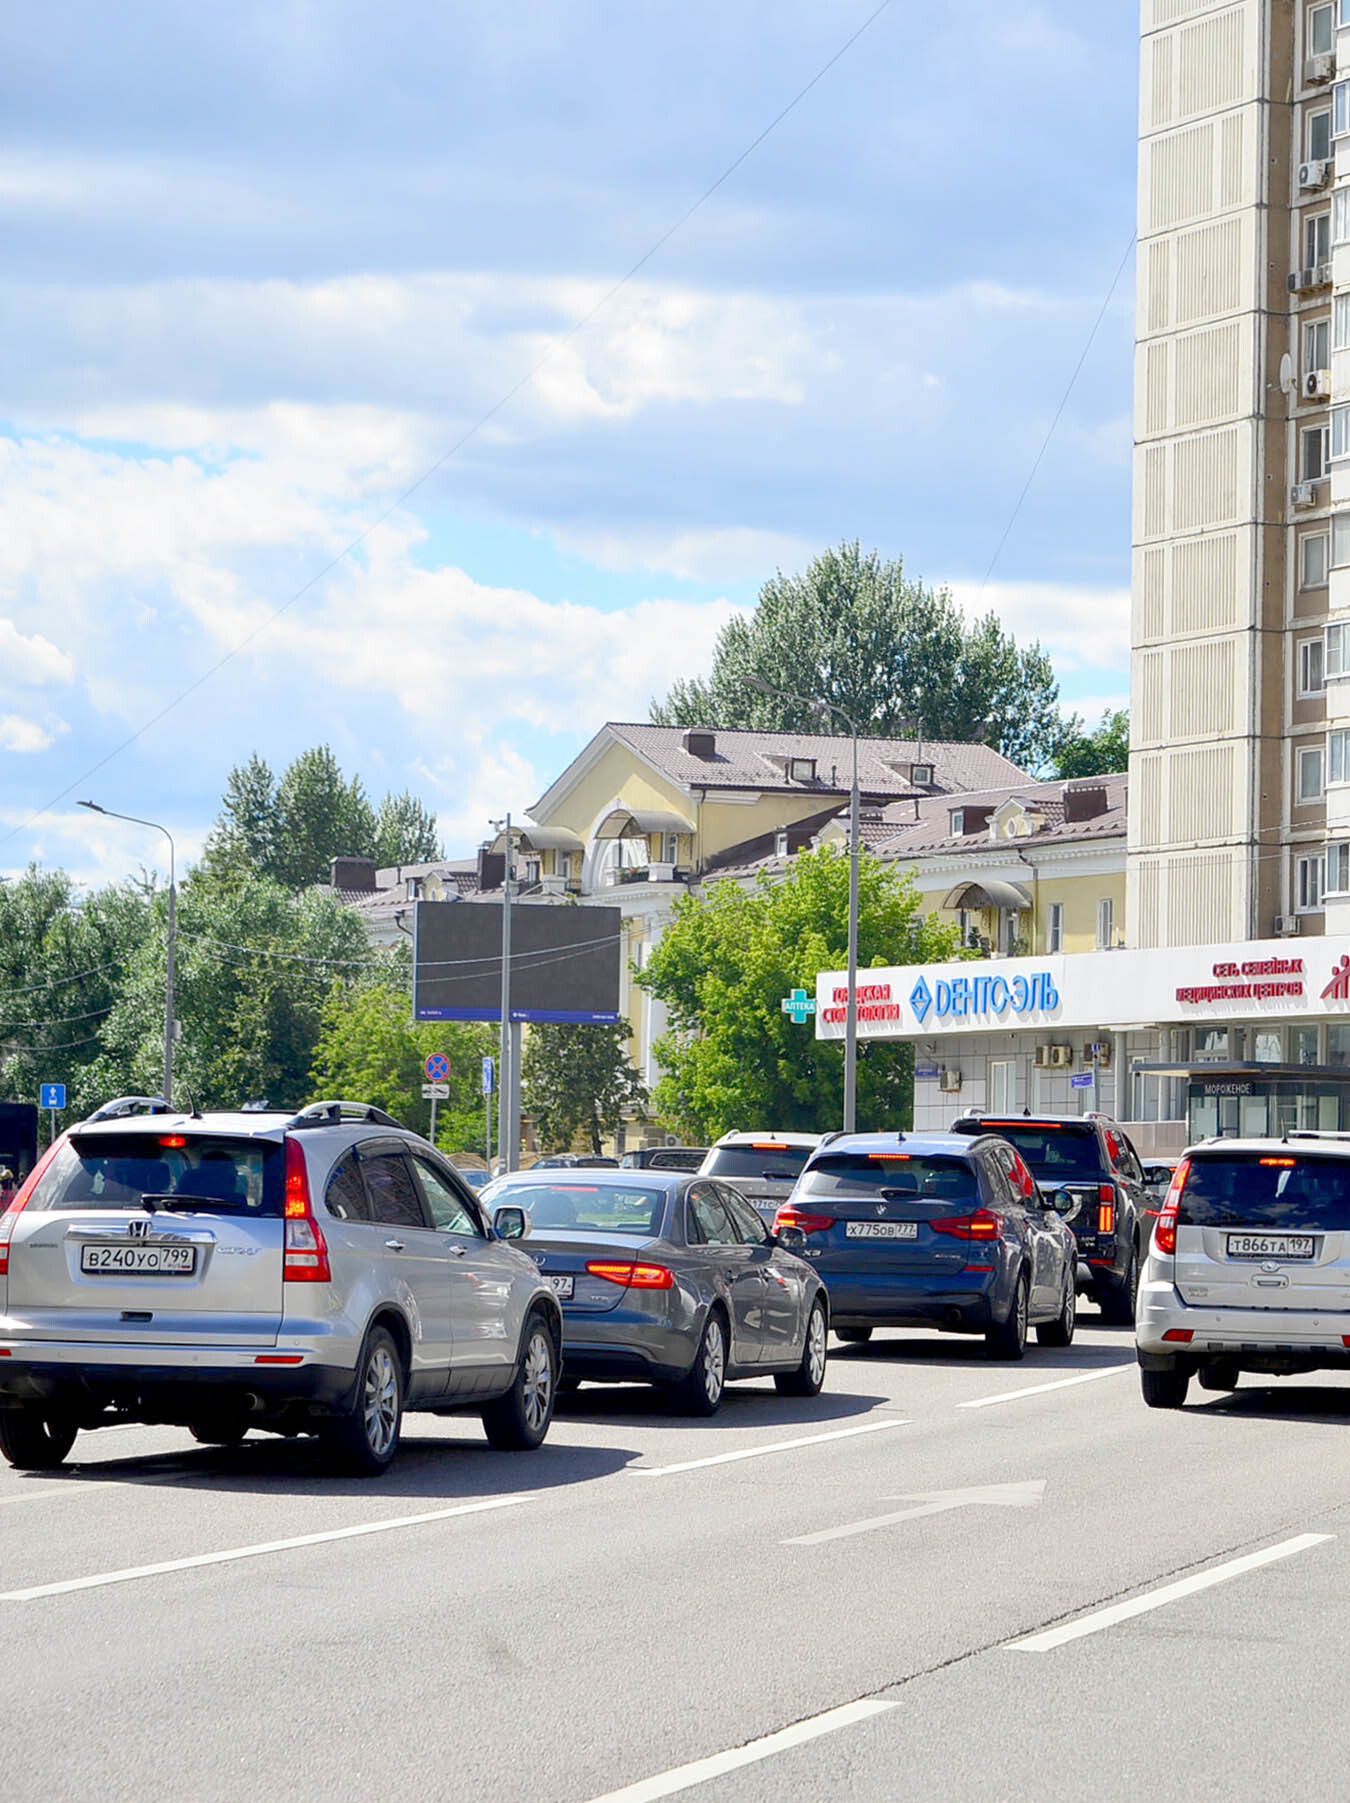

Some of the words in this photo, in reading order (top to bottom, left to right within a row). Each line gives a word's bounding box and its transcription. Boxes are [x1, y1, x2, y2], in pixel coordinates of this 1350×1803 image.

[823, 1004, 900, 1024] СТОМТОЛОГИЯ
[1204, 1083, 1250, 1095] МОРОЖЕНОЕ
[162, 1248, 190, 1264] 799
